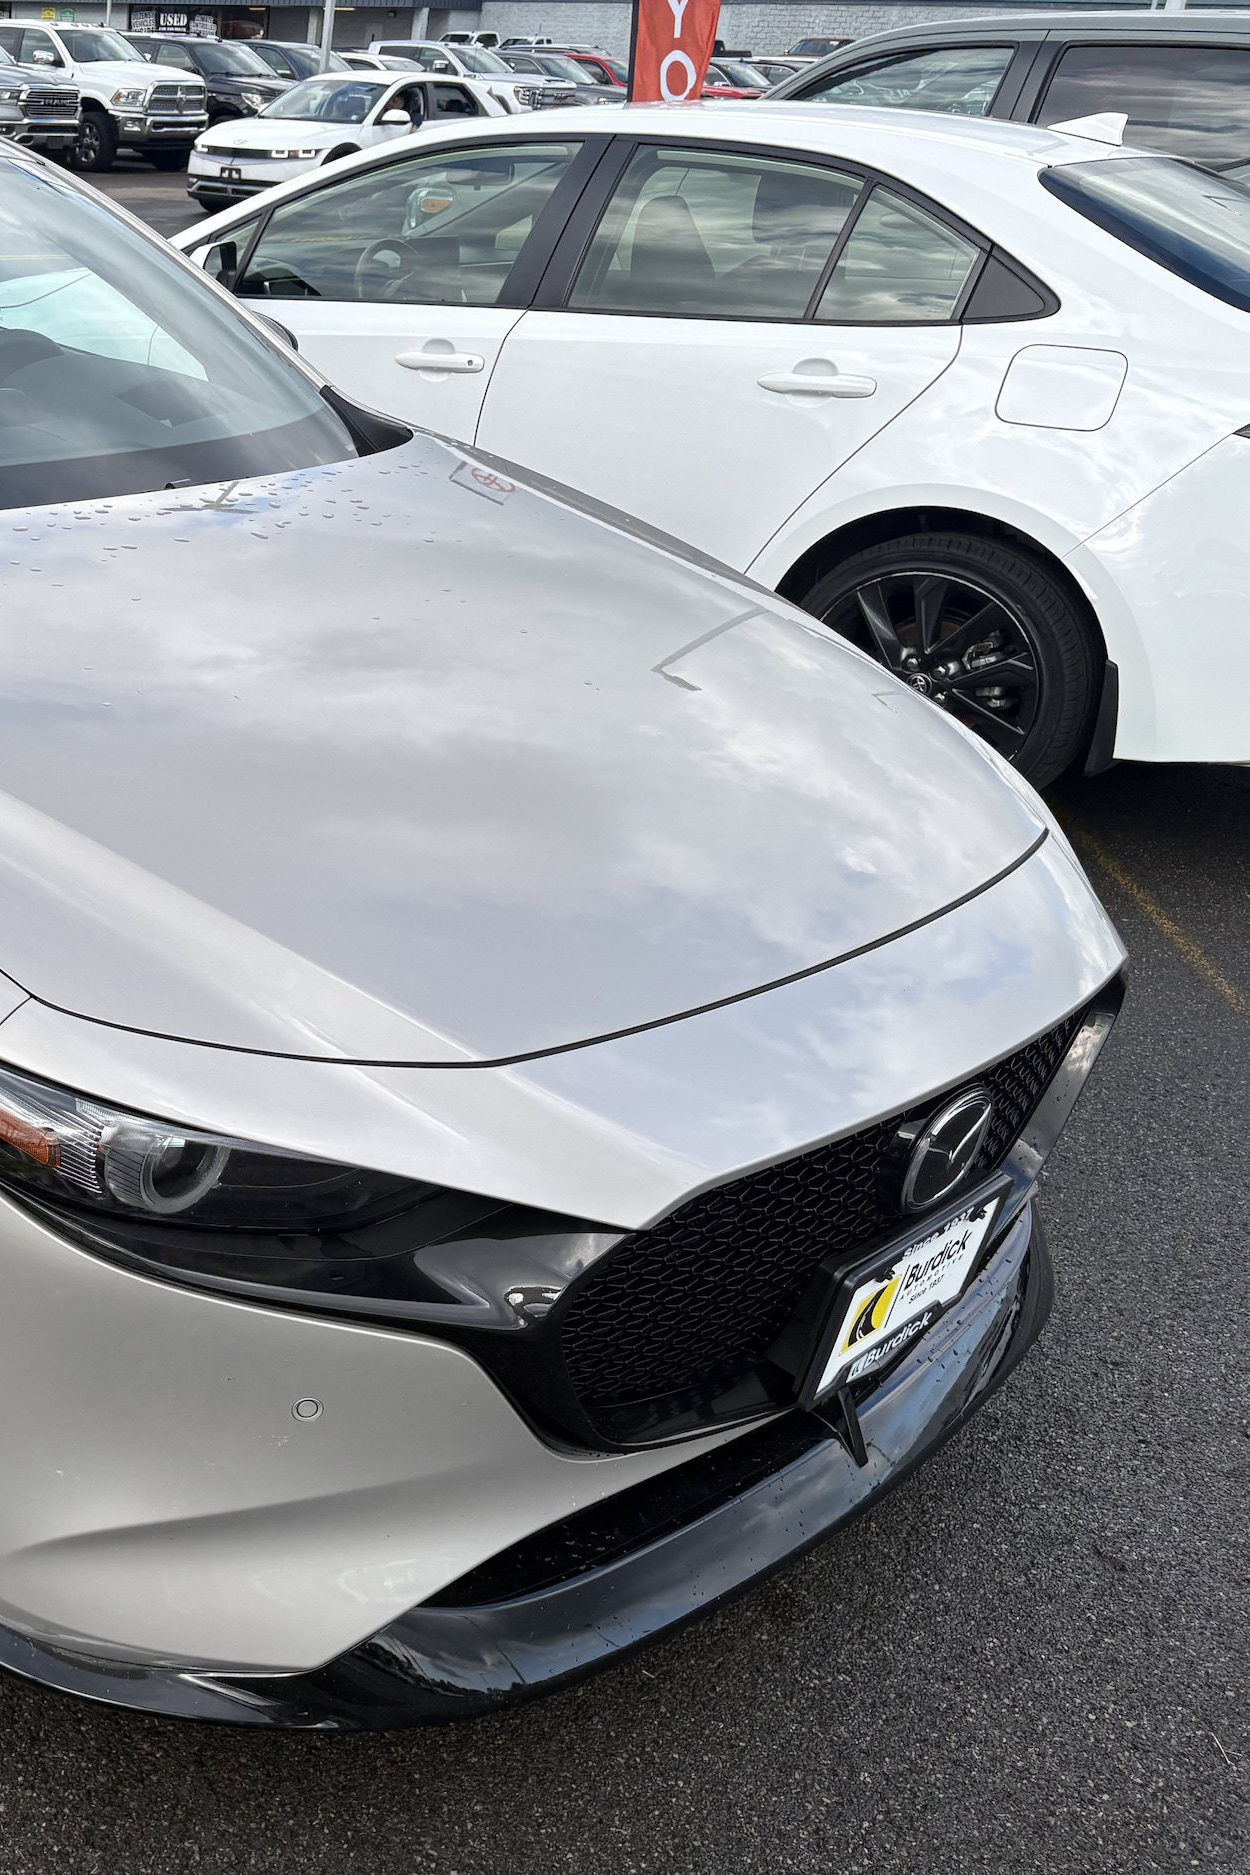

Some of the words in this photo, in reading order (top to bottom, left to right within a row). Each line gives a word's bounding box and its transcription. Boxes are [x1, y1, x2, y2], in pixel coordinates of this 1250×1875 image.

[160, 13, 188, 26] USED
[904, 1229, 973, 1291] Burdick
[863, 1311, 933, 1369] Burdick
